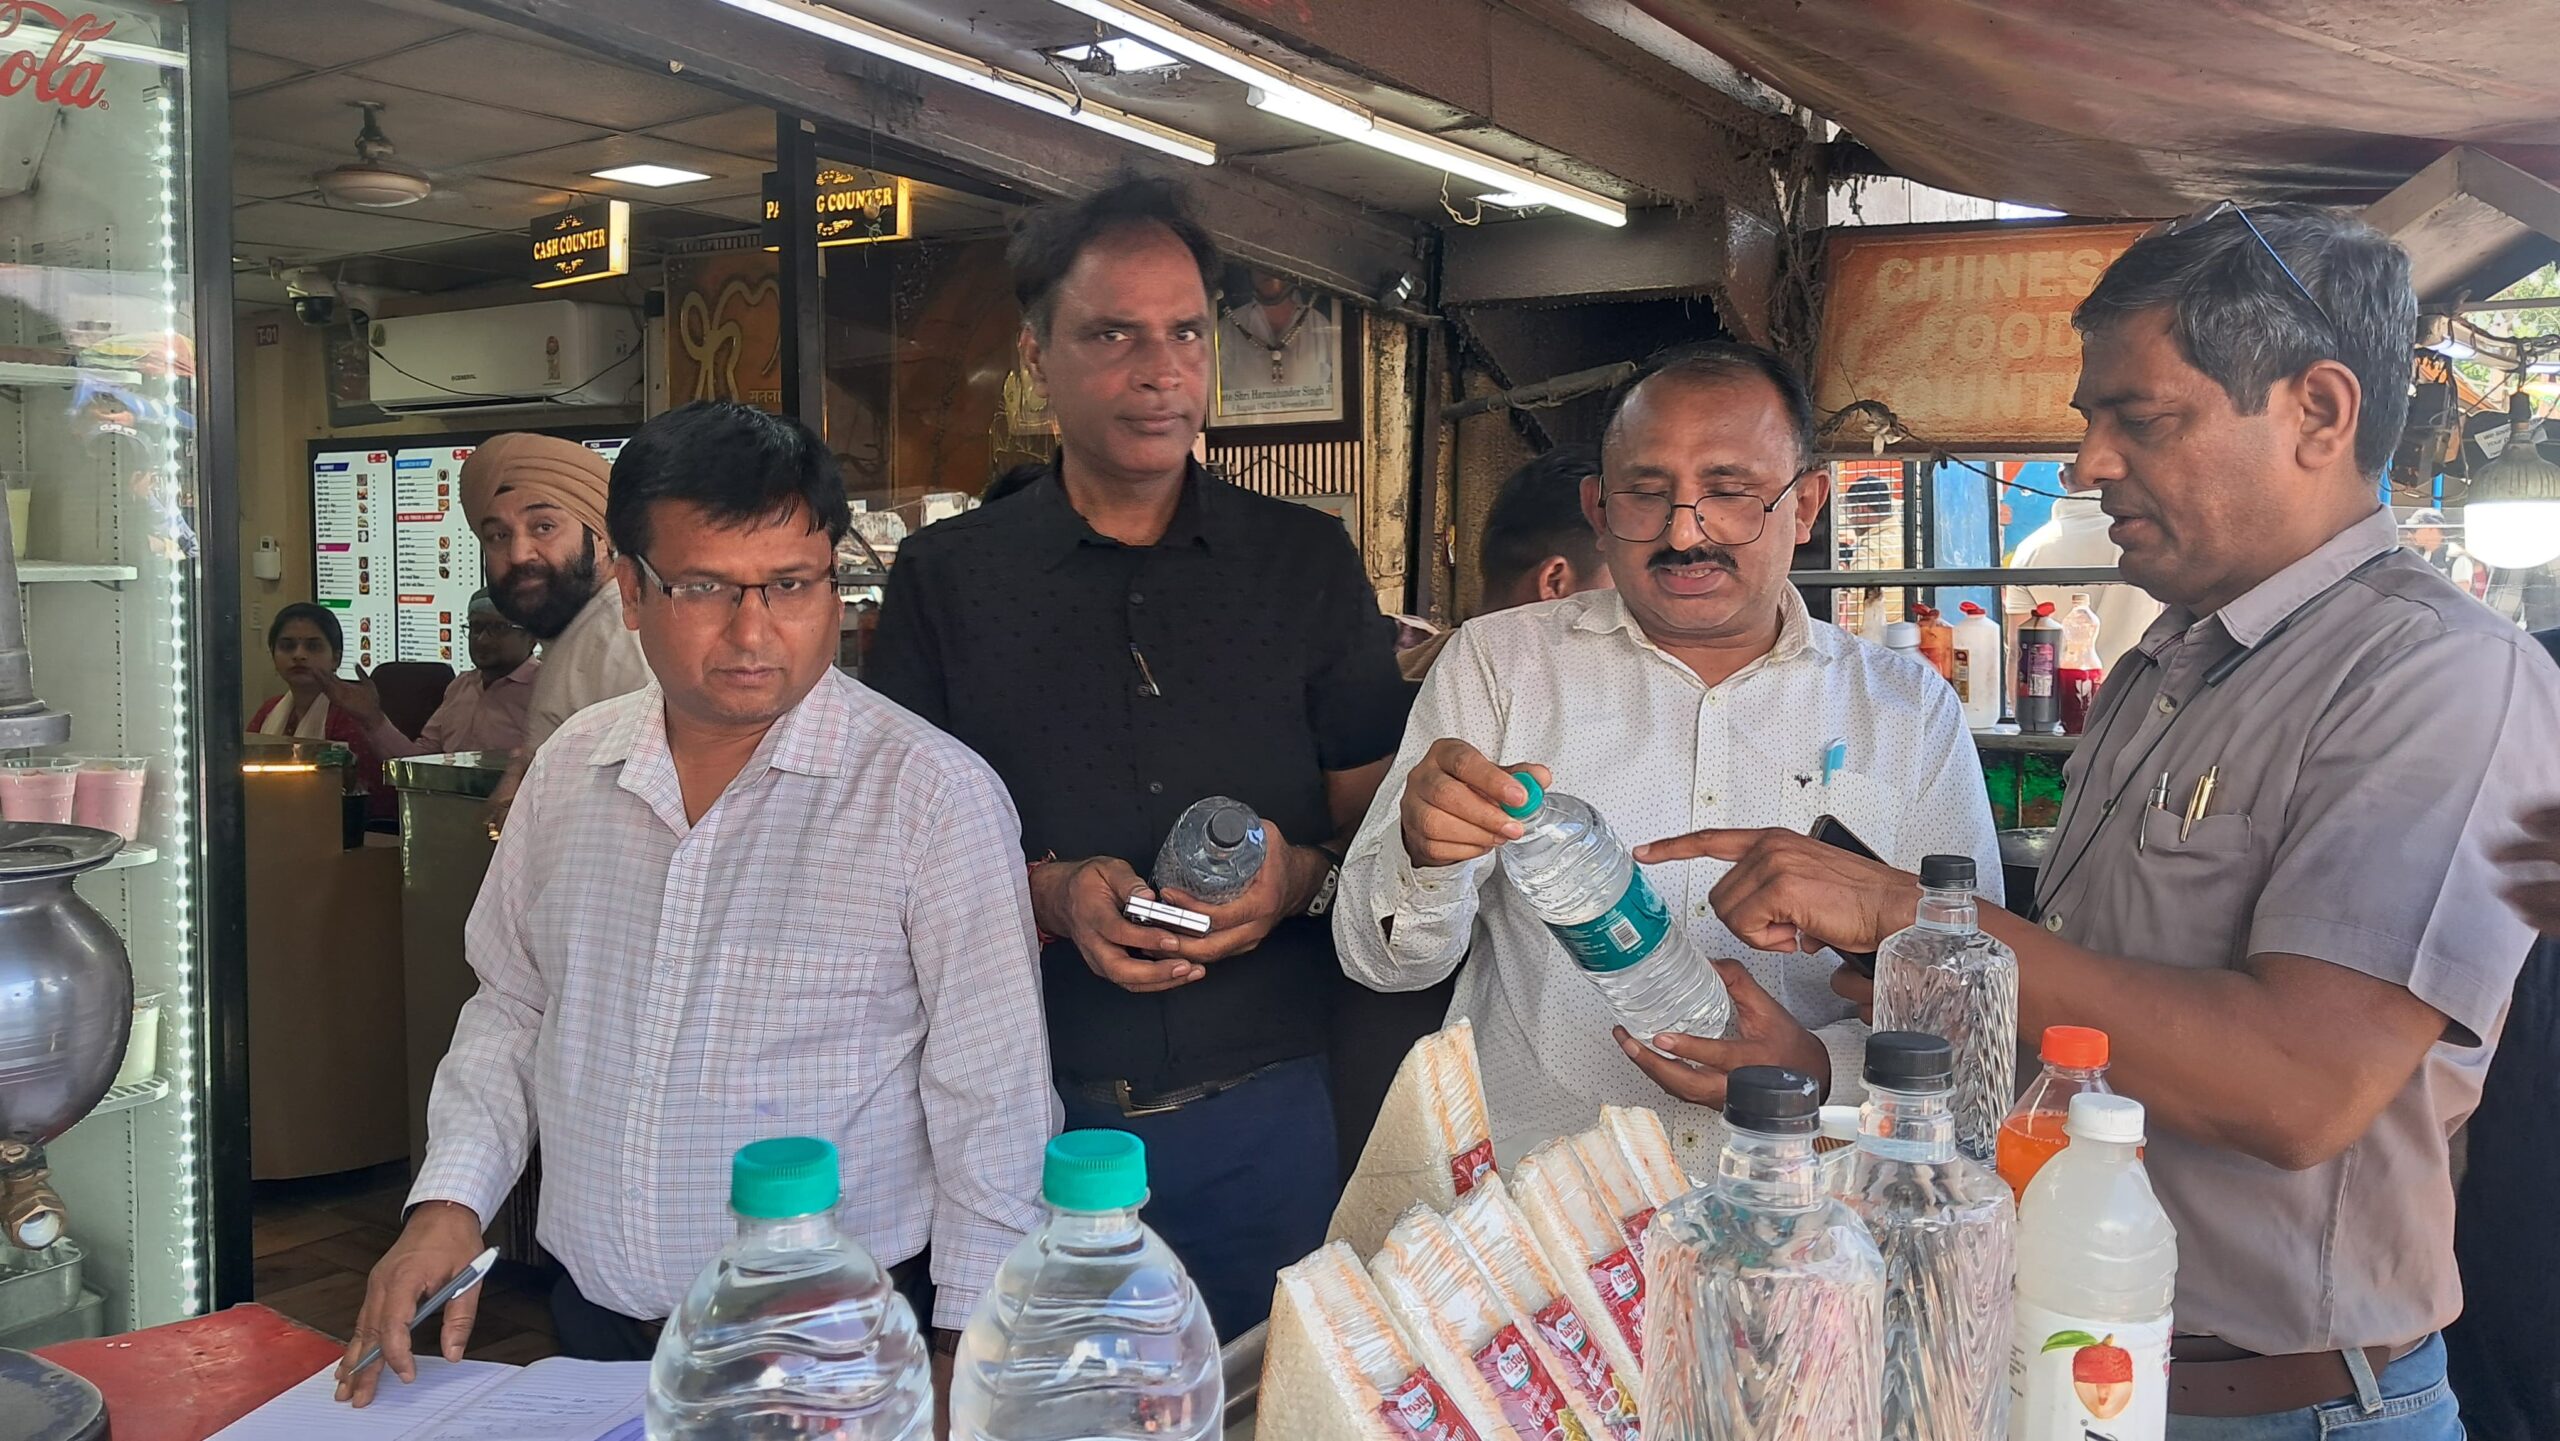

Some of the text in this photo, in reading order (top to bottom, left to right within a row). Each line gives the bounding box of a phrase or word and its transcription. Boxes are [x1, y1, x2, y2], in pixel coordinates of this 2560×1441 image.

[533, 228, 606, 260] CASH COUNTER
[1502, 1351, 1528, 1376] tasty
[1401, 1391, 1433, 1416] tasty
